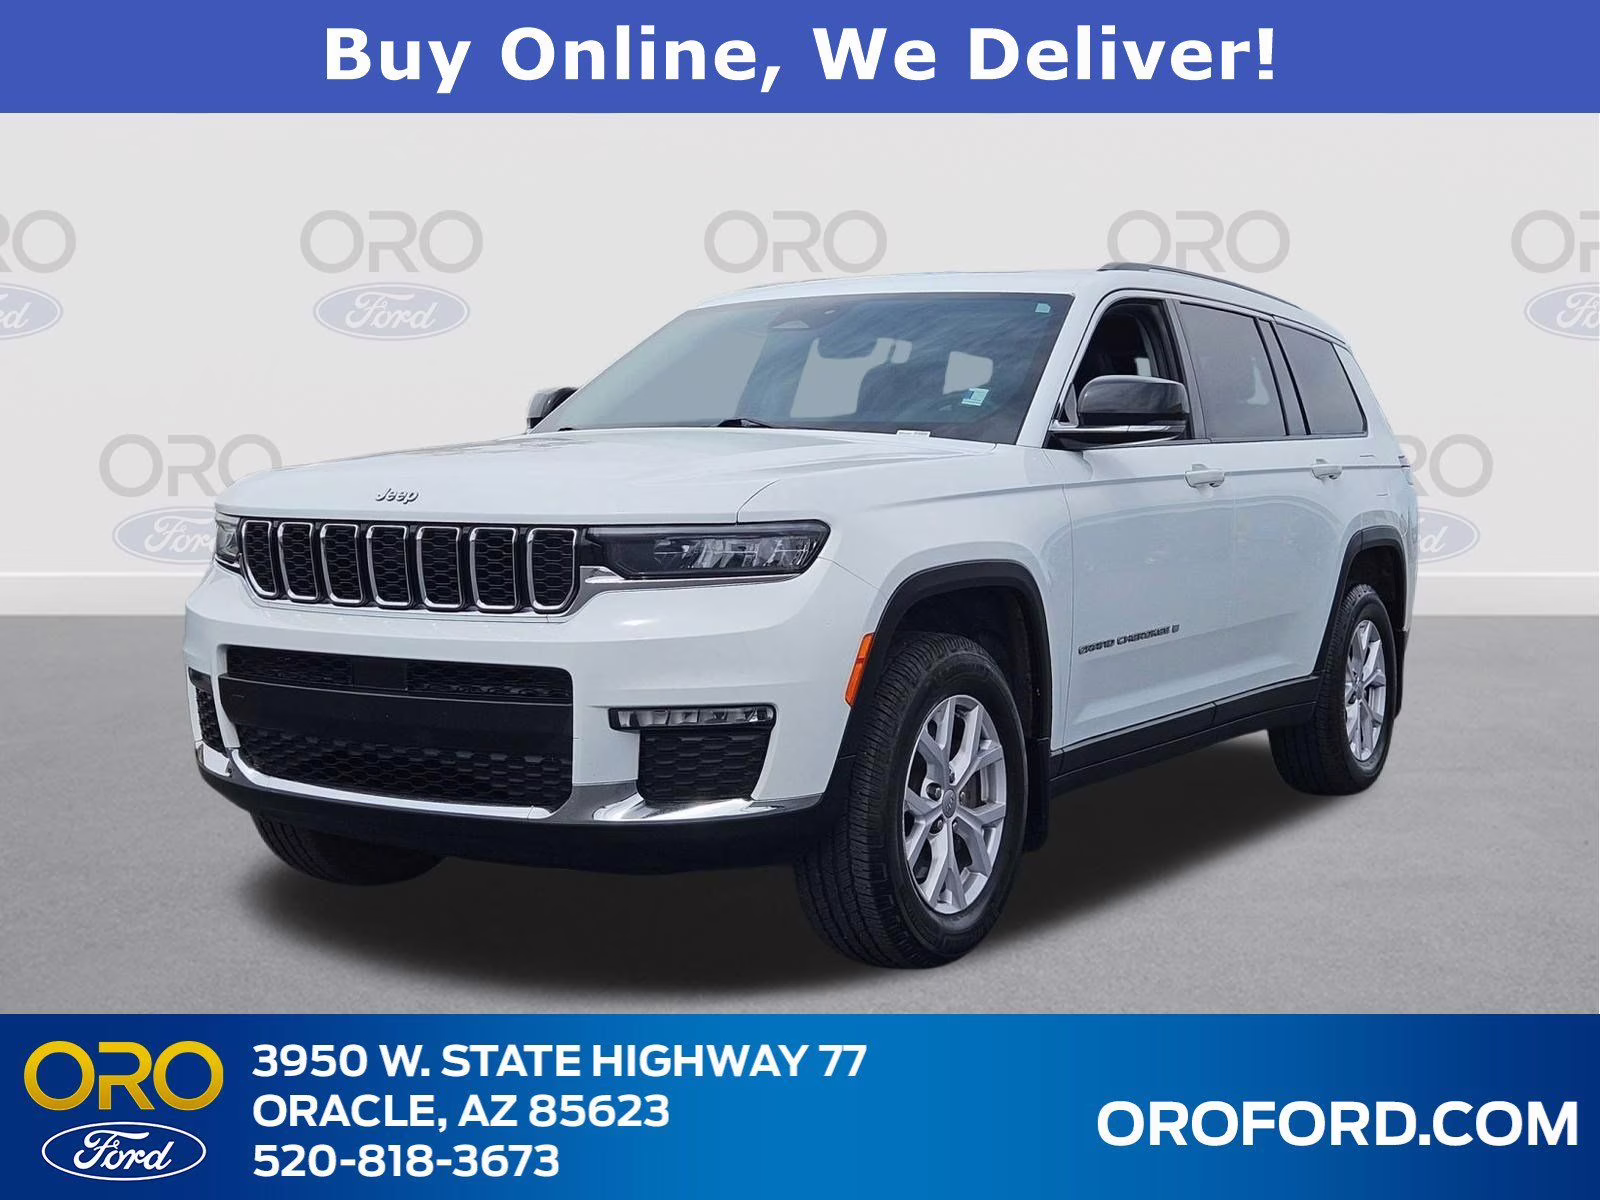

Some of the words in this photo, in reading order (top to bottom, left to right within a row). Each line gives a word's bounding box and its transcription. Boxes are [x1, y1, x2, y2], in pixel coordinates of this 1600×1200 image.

[300, 210, 483, 273] ORO
[704, 210, 887, 273] ORO
[1107, 210, 1290, 273] ORO
[345, 291, 439, 329] Ford
[375, 487, 420, 505] Jeep
[144, 515, 214, 552] For
